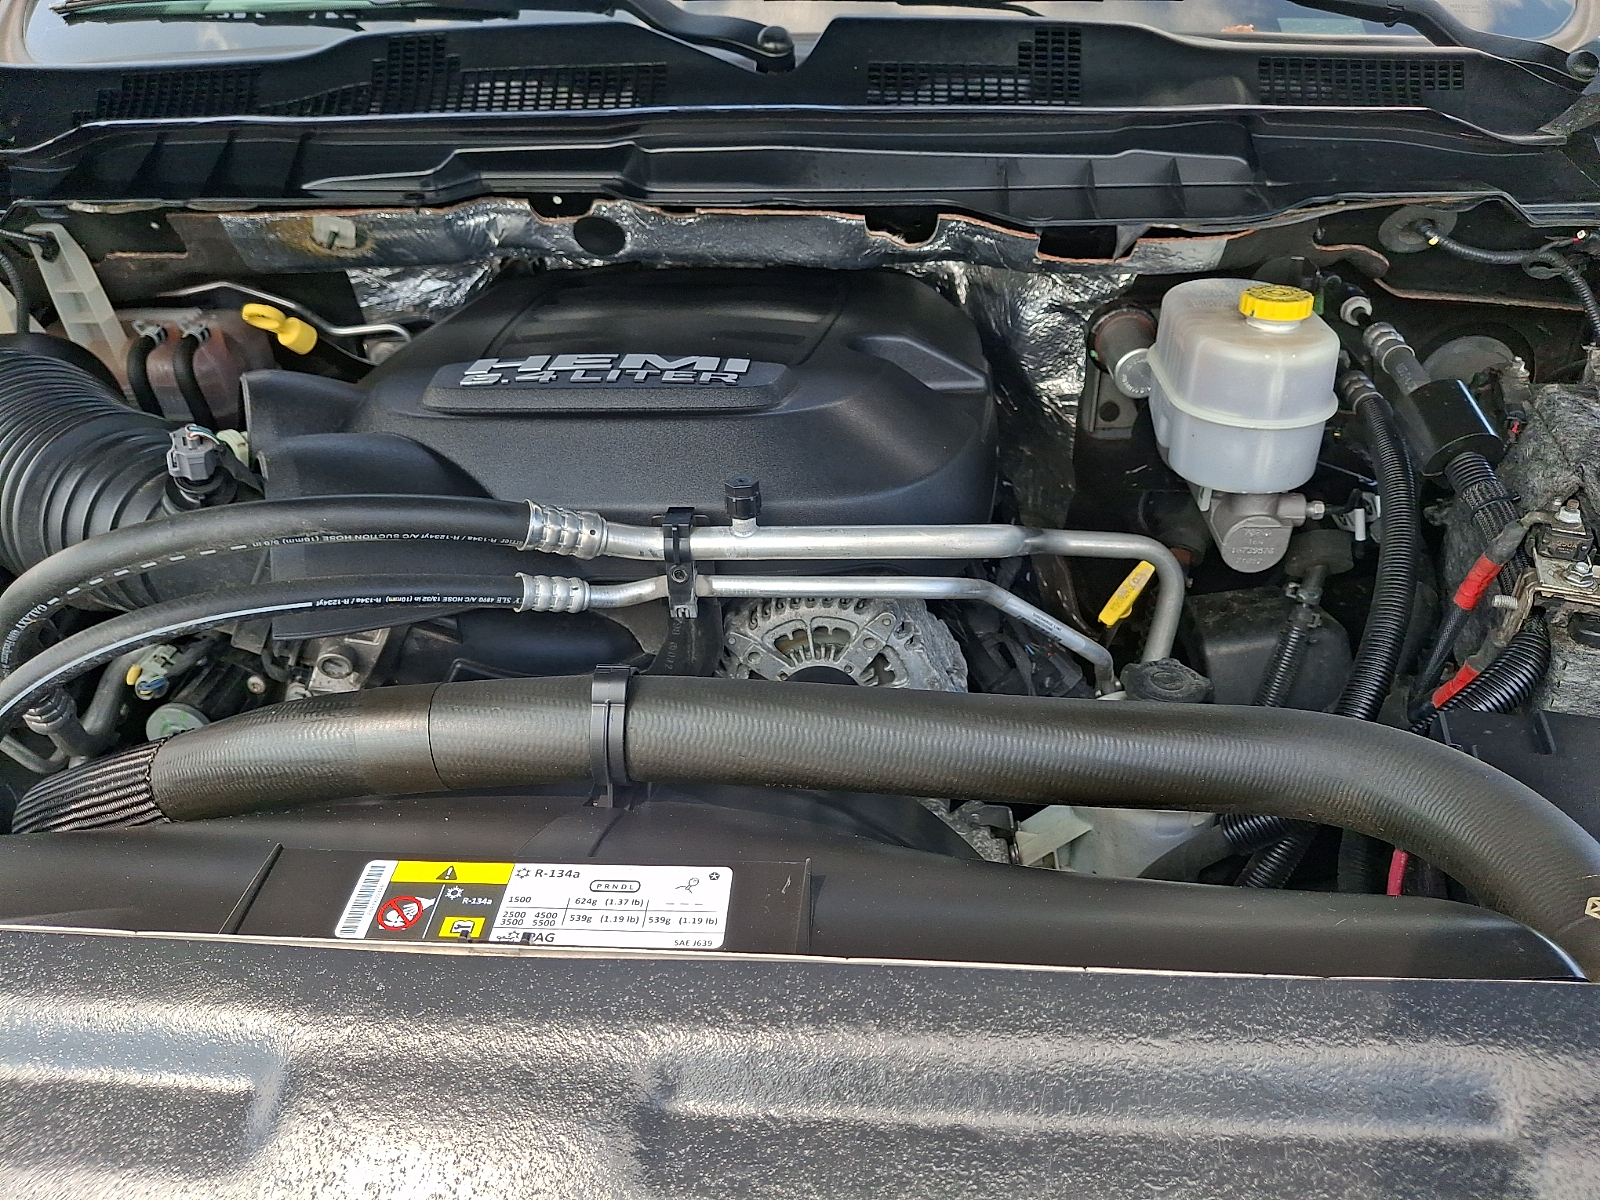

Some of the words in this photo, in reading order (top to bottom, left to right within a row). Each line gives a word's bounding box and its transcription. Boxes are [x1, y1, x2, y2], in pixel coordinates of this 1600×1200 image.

[464, 354, 750, 375] HEMI
[570, 370, 739, 386] LITER
[282, 536, 320, 545] (16mm)
[421, 532, 460, 541] R-1234yf
[467, 535, 497, 543] R-134a
[315, 598, 349, 607] R-1234yf
[15, 604, 48, 631] GALAXY
[535, 869, 580, 878] R-134a
[462, 897, 493, 905] R-134a
[575, 898, 598, 906] 624g
[605, 898, 629, 907] (1.37
[631, 898, 644, 907] lb)
[532, 919, 556, 927] 5500
[569, 915, 592, 923] 539g
[600, 915, 624, 924] (1.19
[626, 916, 640, 924] lb)
[648, 917, 671, 925] 539g
[678, 917, 703, 926] (1.19
[705, 917, 718, 926] lb)
